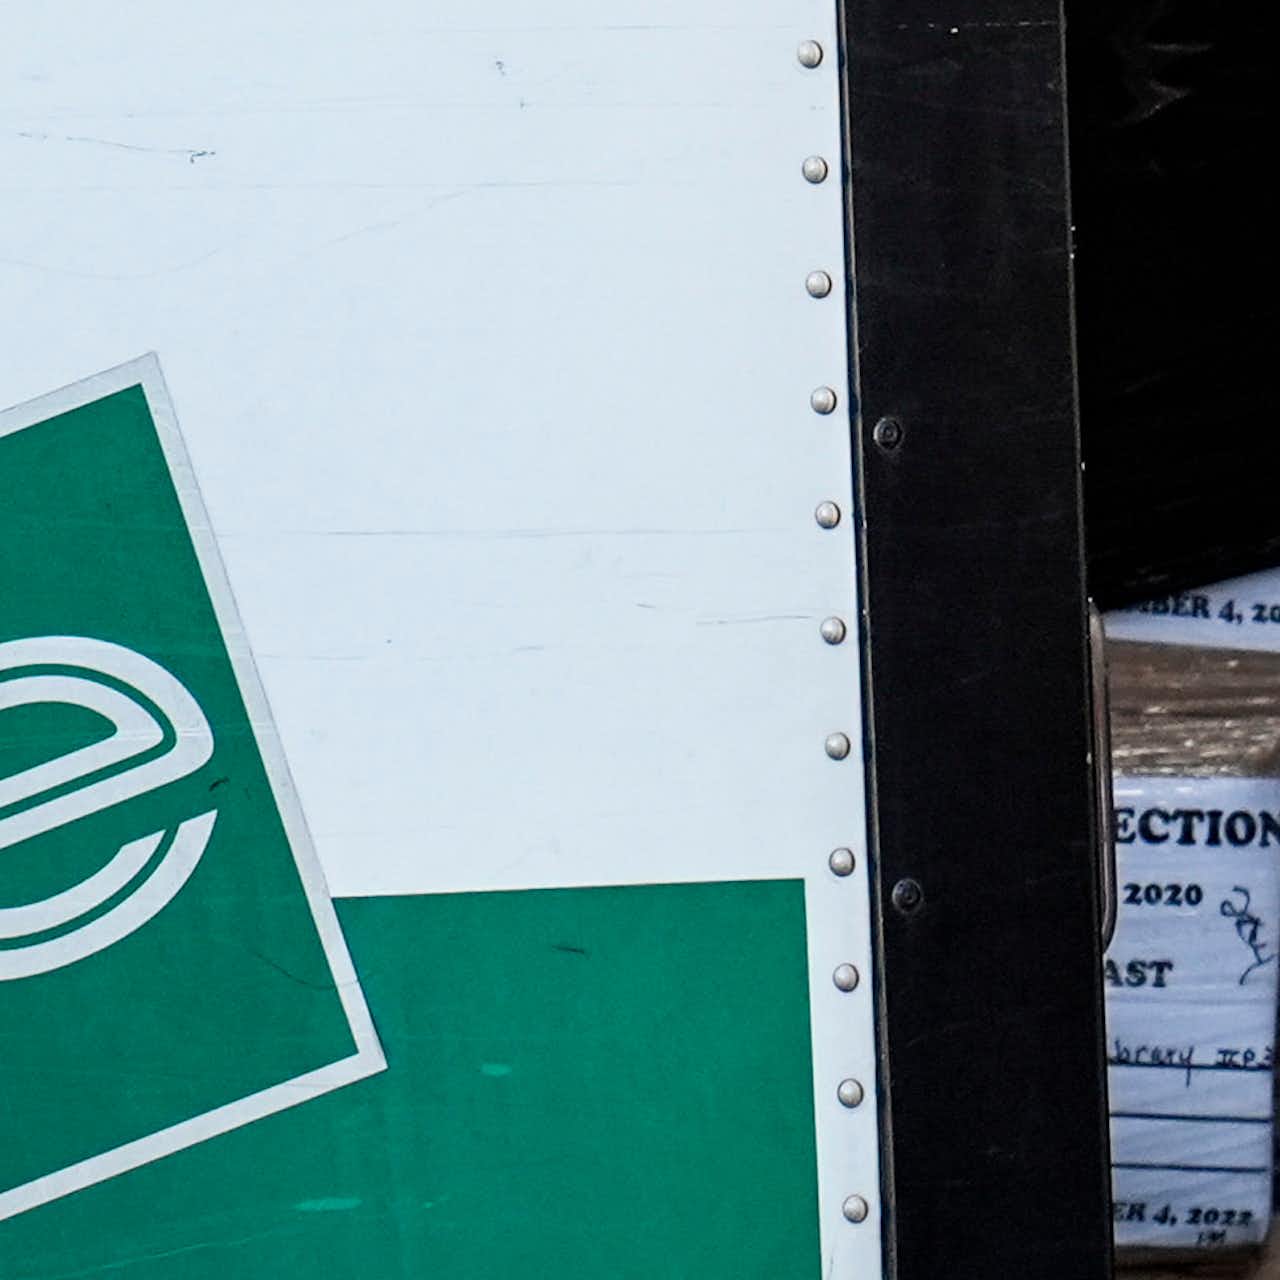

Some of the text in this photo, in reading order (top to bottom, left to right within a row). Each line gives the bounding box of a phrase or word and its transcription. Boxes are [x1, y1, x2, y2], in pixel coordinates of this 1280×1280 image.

[1217, 601, 1243, 624] 4,
[1123, 884, 1204, 907] 2020
[1153, 1205, 1178, 1226] 4,
